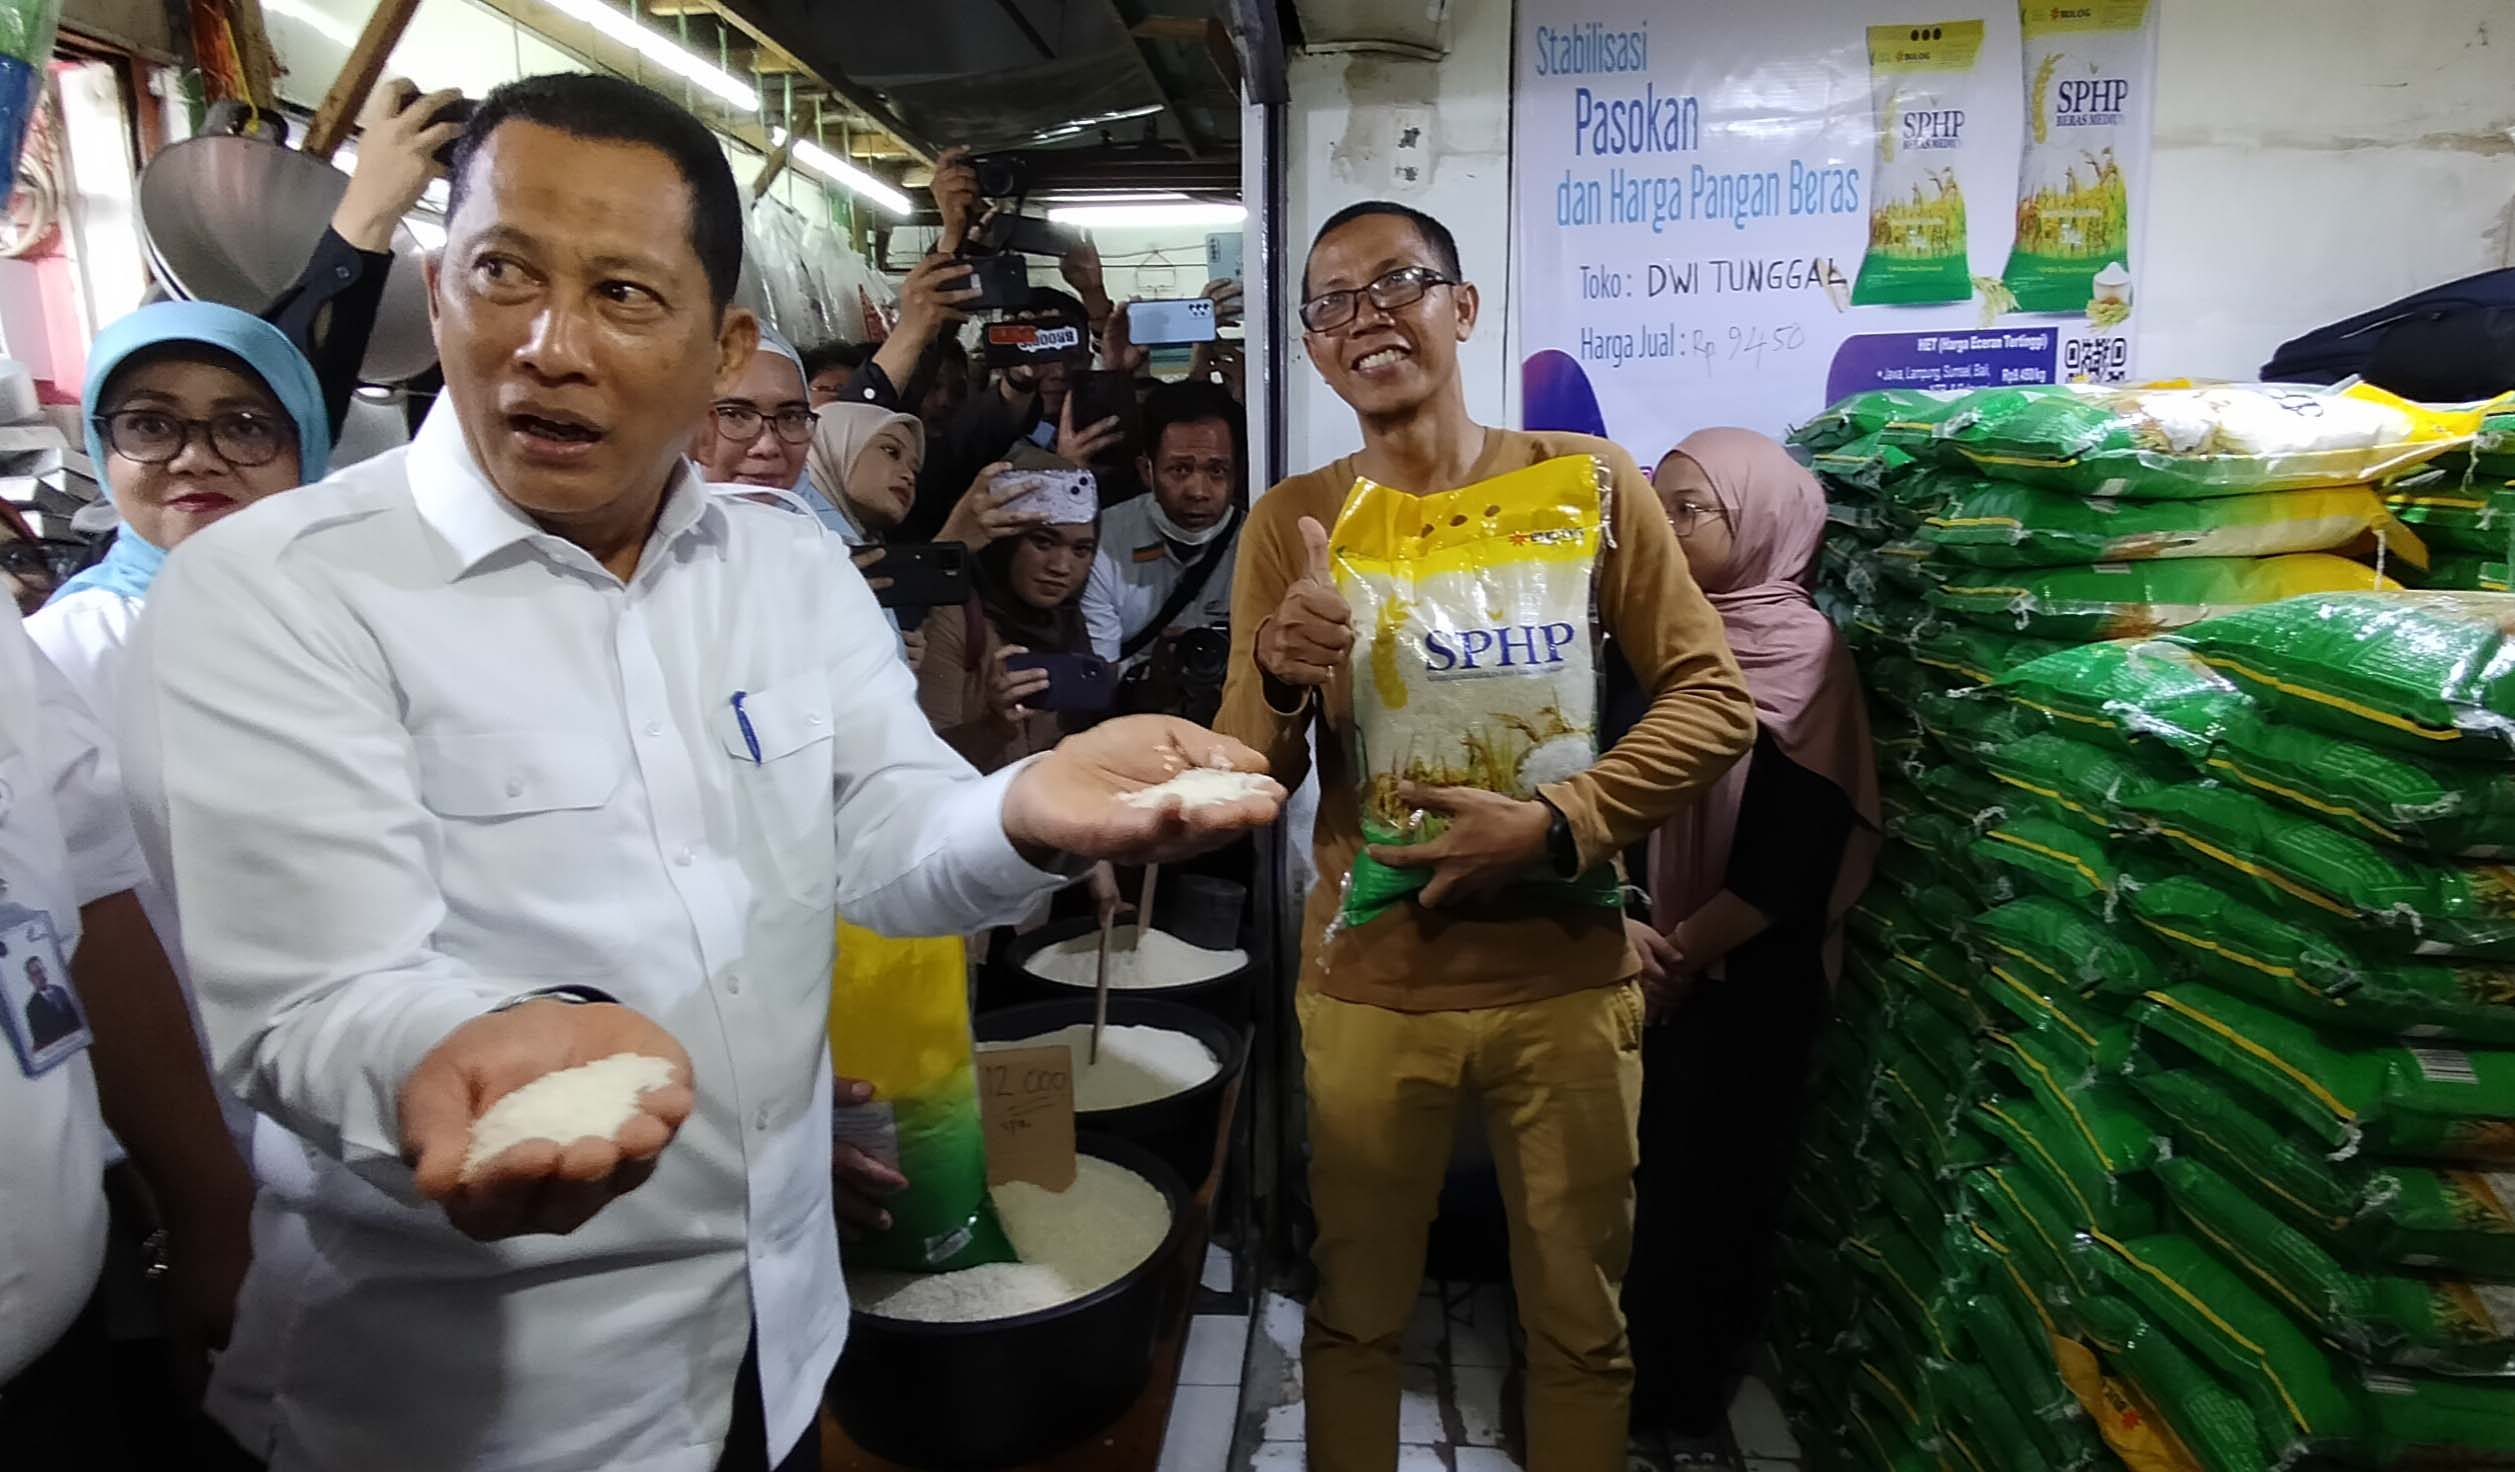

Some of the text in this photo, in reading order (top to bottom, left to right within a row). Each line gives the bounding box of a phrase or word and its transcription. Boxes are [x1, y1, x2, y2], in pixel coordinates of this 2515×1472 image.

[1535, 20, 1648, 77] Stabilisasi
[1575, 82, 1699, 156] Pasokan
[2056, 79, 2129, 113] SPHP
[1903, 110, 1966, 139] SPHP
[1556, 158, 1860, 234] dan Harga Pangan Beras
[1648, 262, 1698, 297] DWI
[1709, 257, 1848, 293] TUNGGAL
[1580, 326, 1633, 368] Harga
[1728, 322, 1805, 369] 9450
[1425, 622, 1575, 671] SPHP
